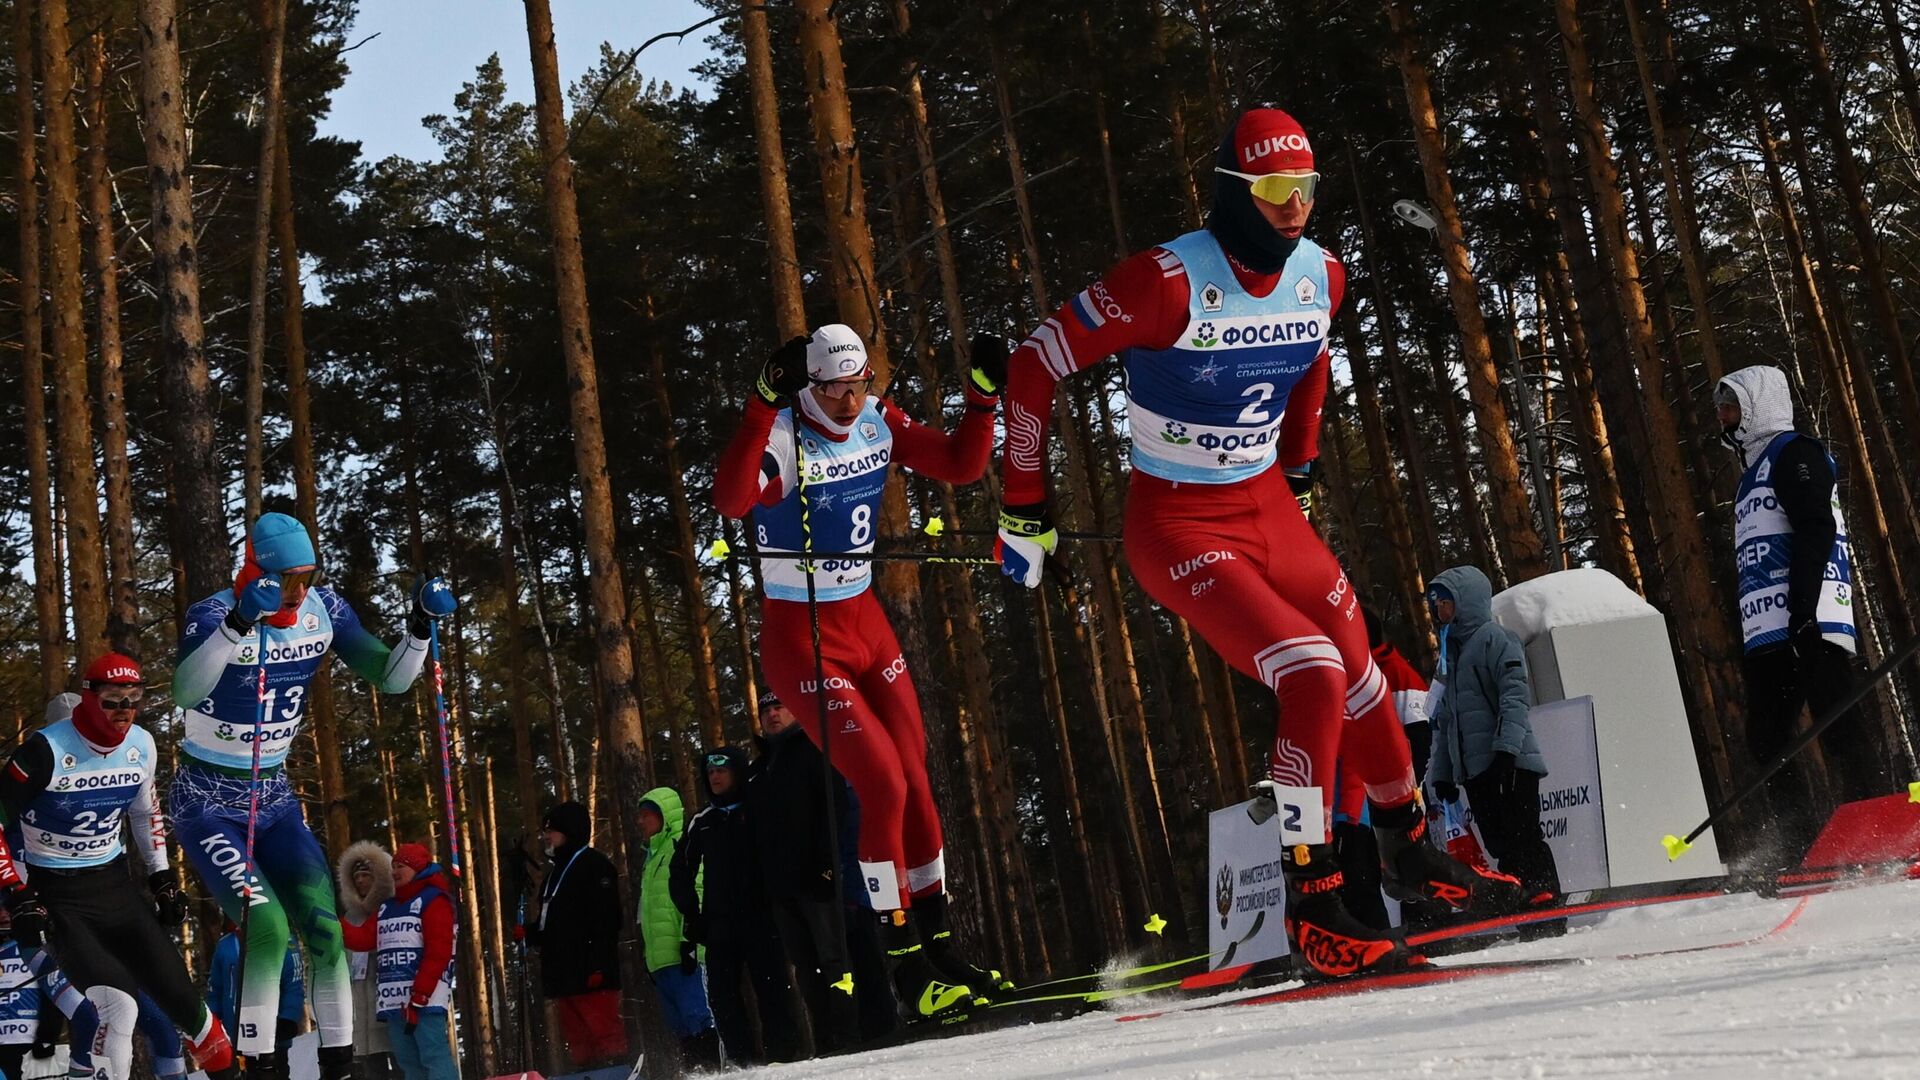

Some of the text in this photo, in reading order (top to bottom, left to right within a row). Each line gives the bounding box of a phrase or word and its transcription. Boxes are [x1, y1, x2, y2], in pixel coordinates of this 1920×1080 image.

[1093, 281, 1122, 318] OSCO
[1222, 320, 1319, 346] ФОСАГРО
[828, 343, 861, 354] LUKOIL
[1236, 365, 1299, 378] СПАРТАКИАДА
[1236, 382, 1275, 424] 2
[826, 448, 889, 479] ФОСАГРО
[757, 524, 768, 545] 8
[850, 504, 871, 546] 8
[1169, 550, 1237, 581] LUKOIL
[1191, 577, 1216, 596] En+
[200, 697, 215, 715] 3
[261, 685, 304, 722] 13
[827, 700, 853, 711] En+
[75, 773, 140, 789] ФОСАГРО
[1539, 785, 1590, 812] ЫЖНЫХ
[25, 809, 37, 824] 4
[70, 808, 122, 836] 24
[1283, 803, 1302, 832] 2
[868, 877, 880, 892] 8
[240, 1023, 258, 1038] 13
